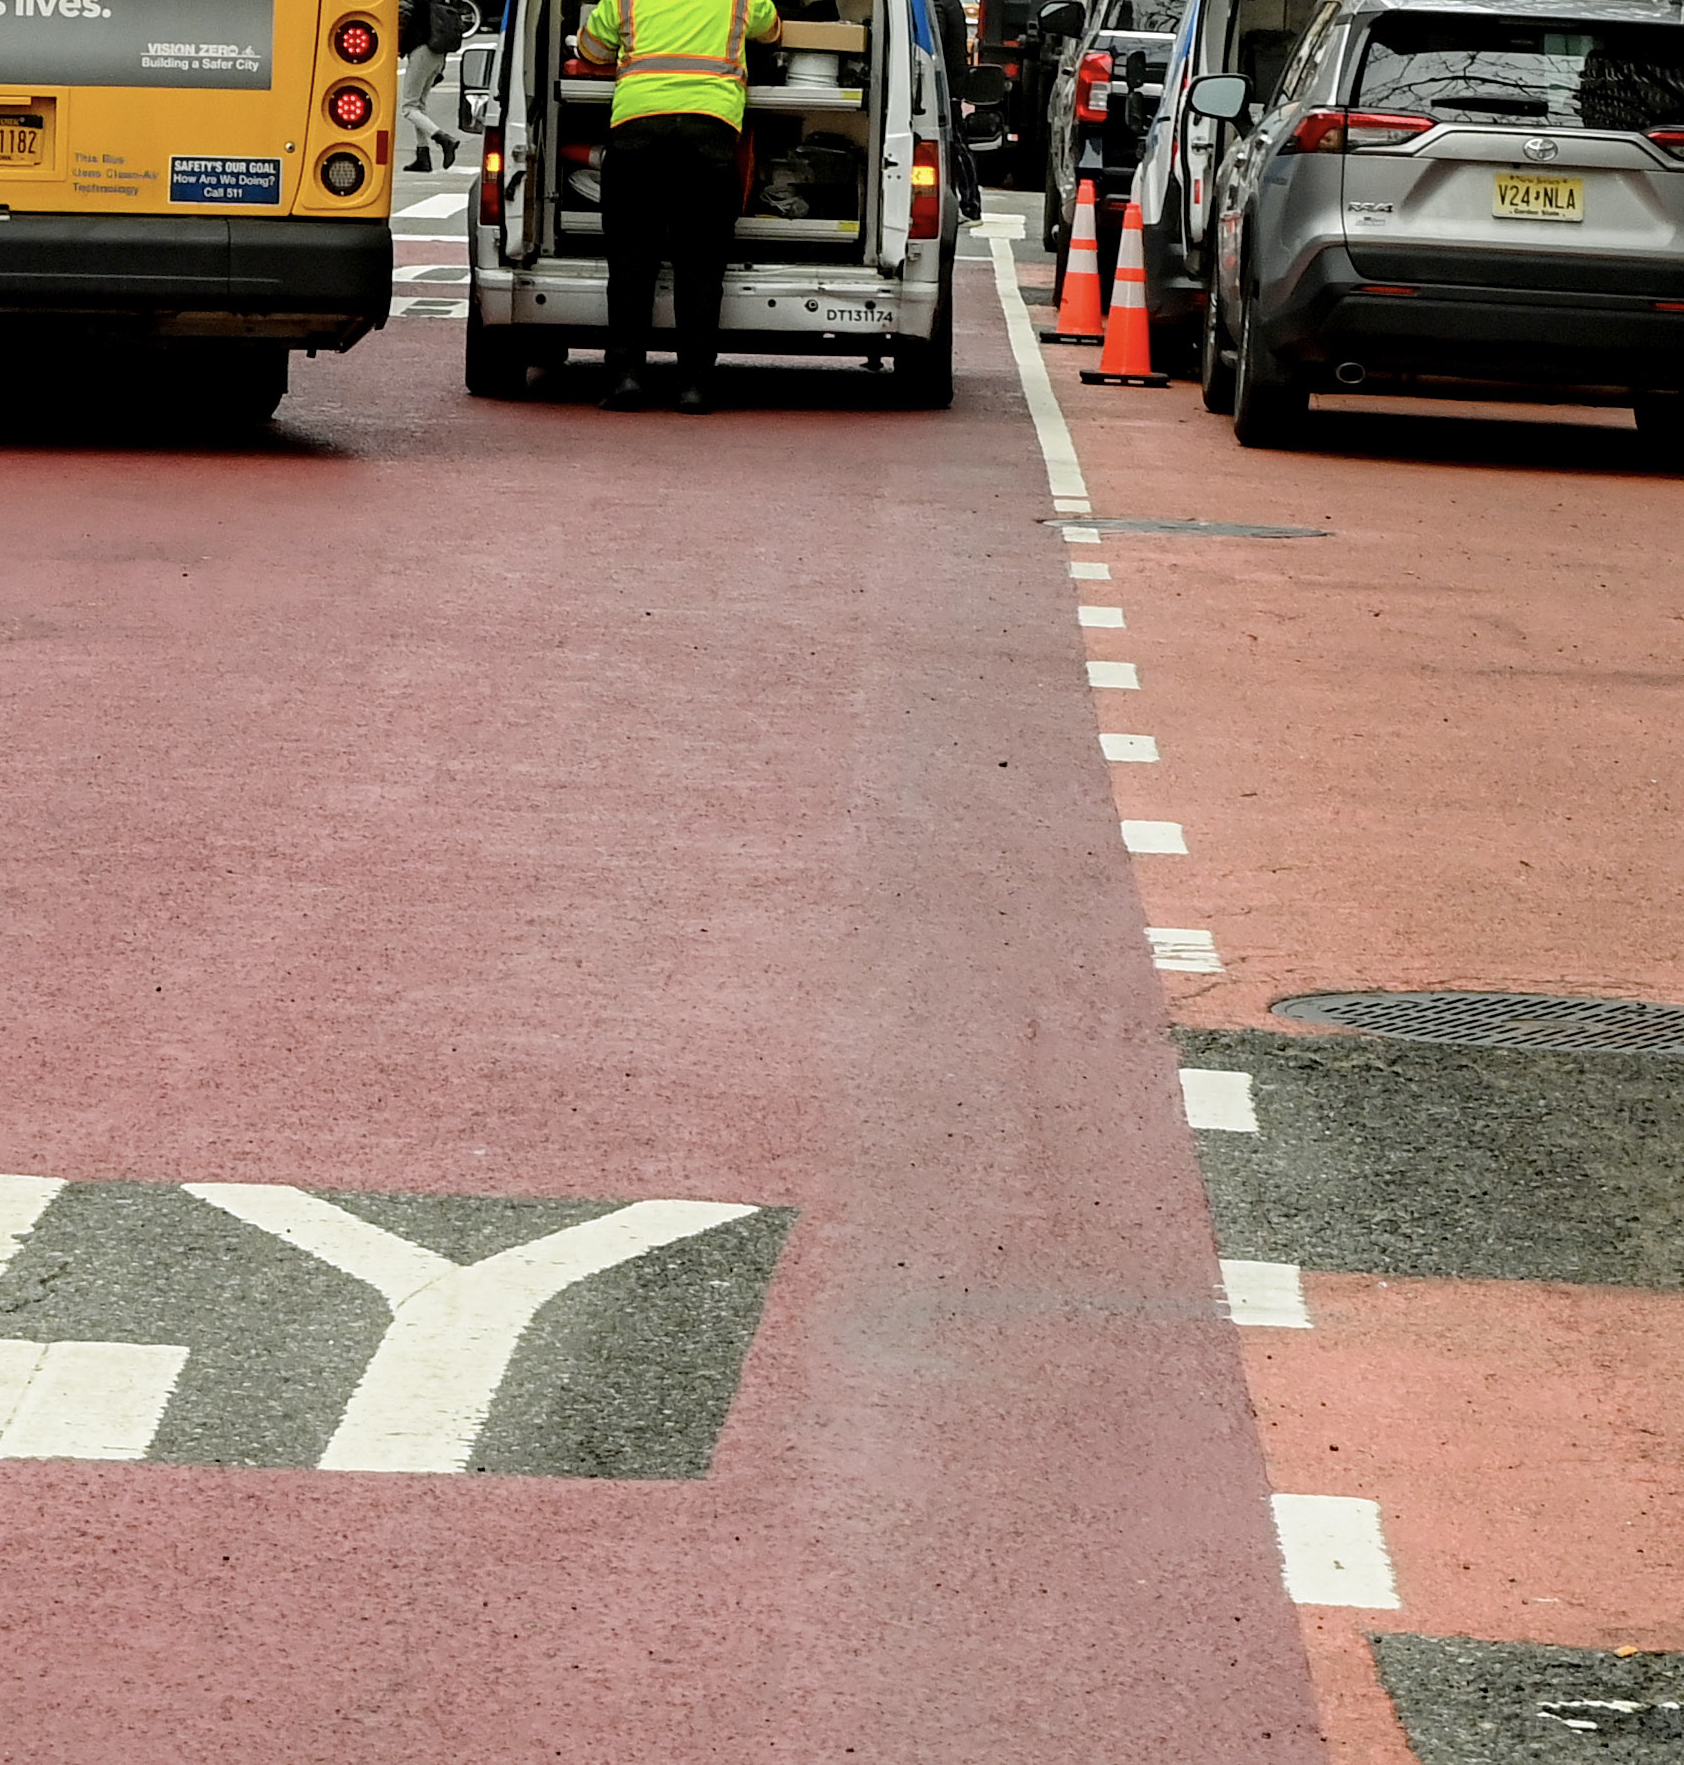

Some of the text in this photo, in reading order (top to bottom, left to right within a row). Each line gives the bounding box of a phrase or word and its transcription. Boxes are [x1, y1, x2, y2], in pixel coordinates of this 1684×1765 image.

[147, 42, 239, 57] VISION ZERO
[141, 57, 259, 73] Building Safer City
[0, 129, 37, 154] 1182
[74, 152, 125, 164] This Bus
[225, 161, 246, 173] OUR
[249, 162, 276, 174] GOAL
[173, 173, 275, 188] How Are We Doing?
[72, 182, 139, 196] Technology
[203, 187, 243, 199] Call 511
[1498, 184, 1576, 210] V24 NLA
[826, 308, 894, 323] DT131174
